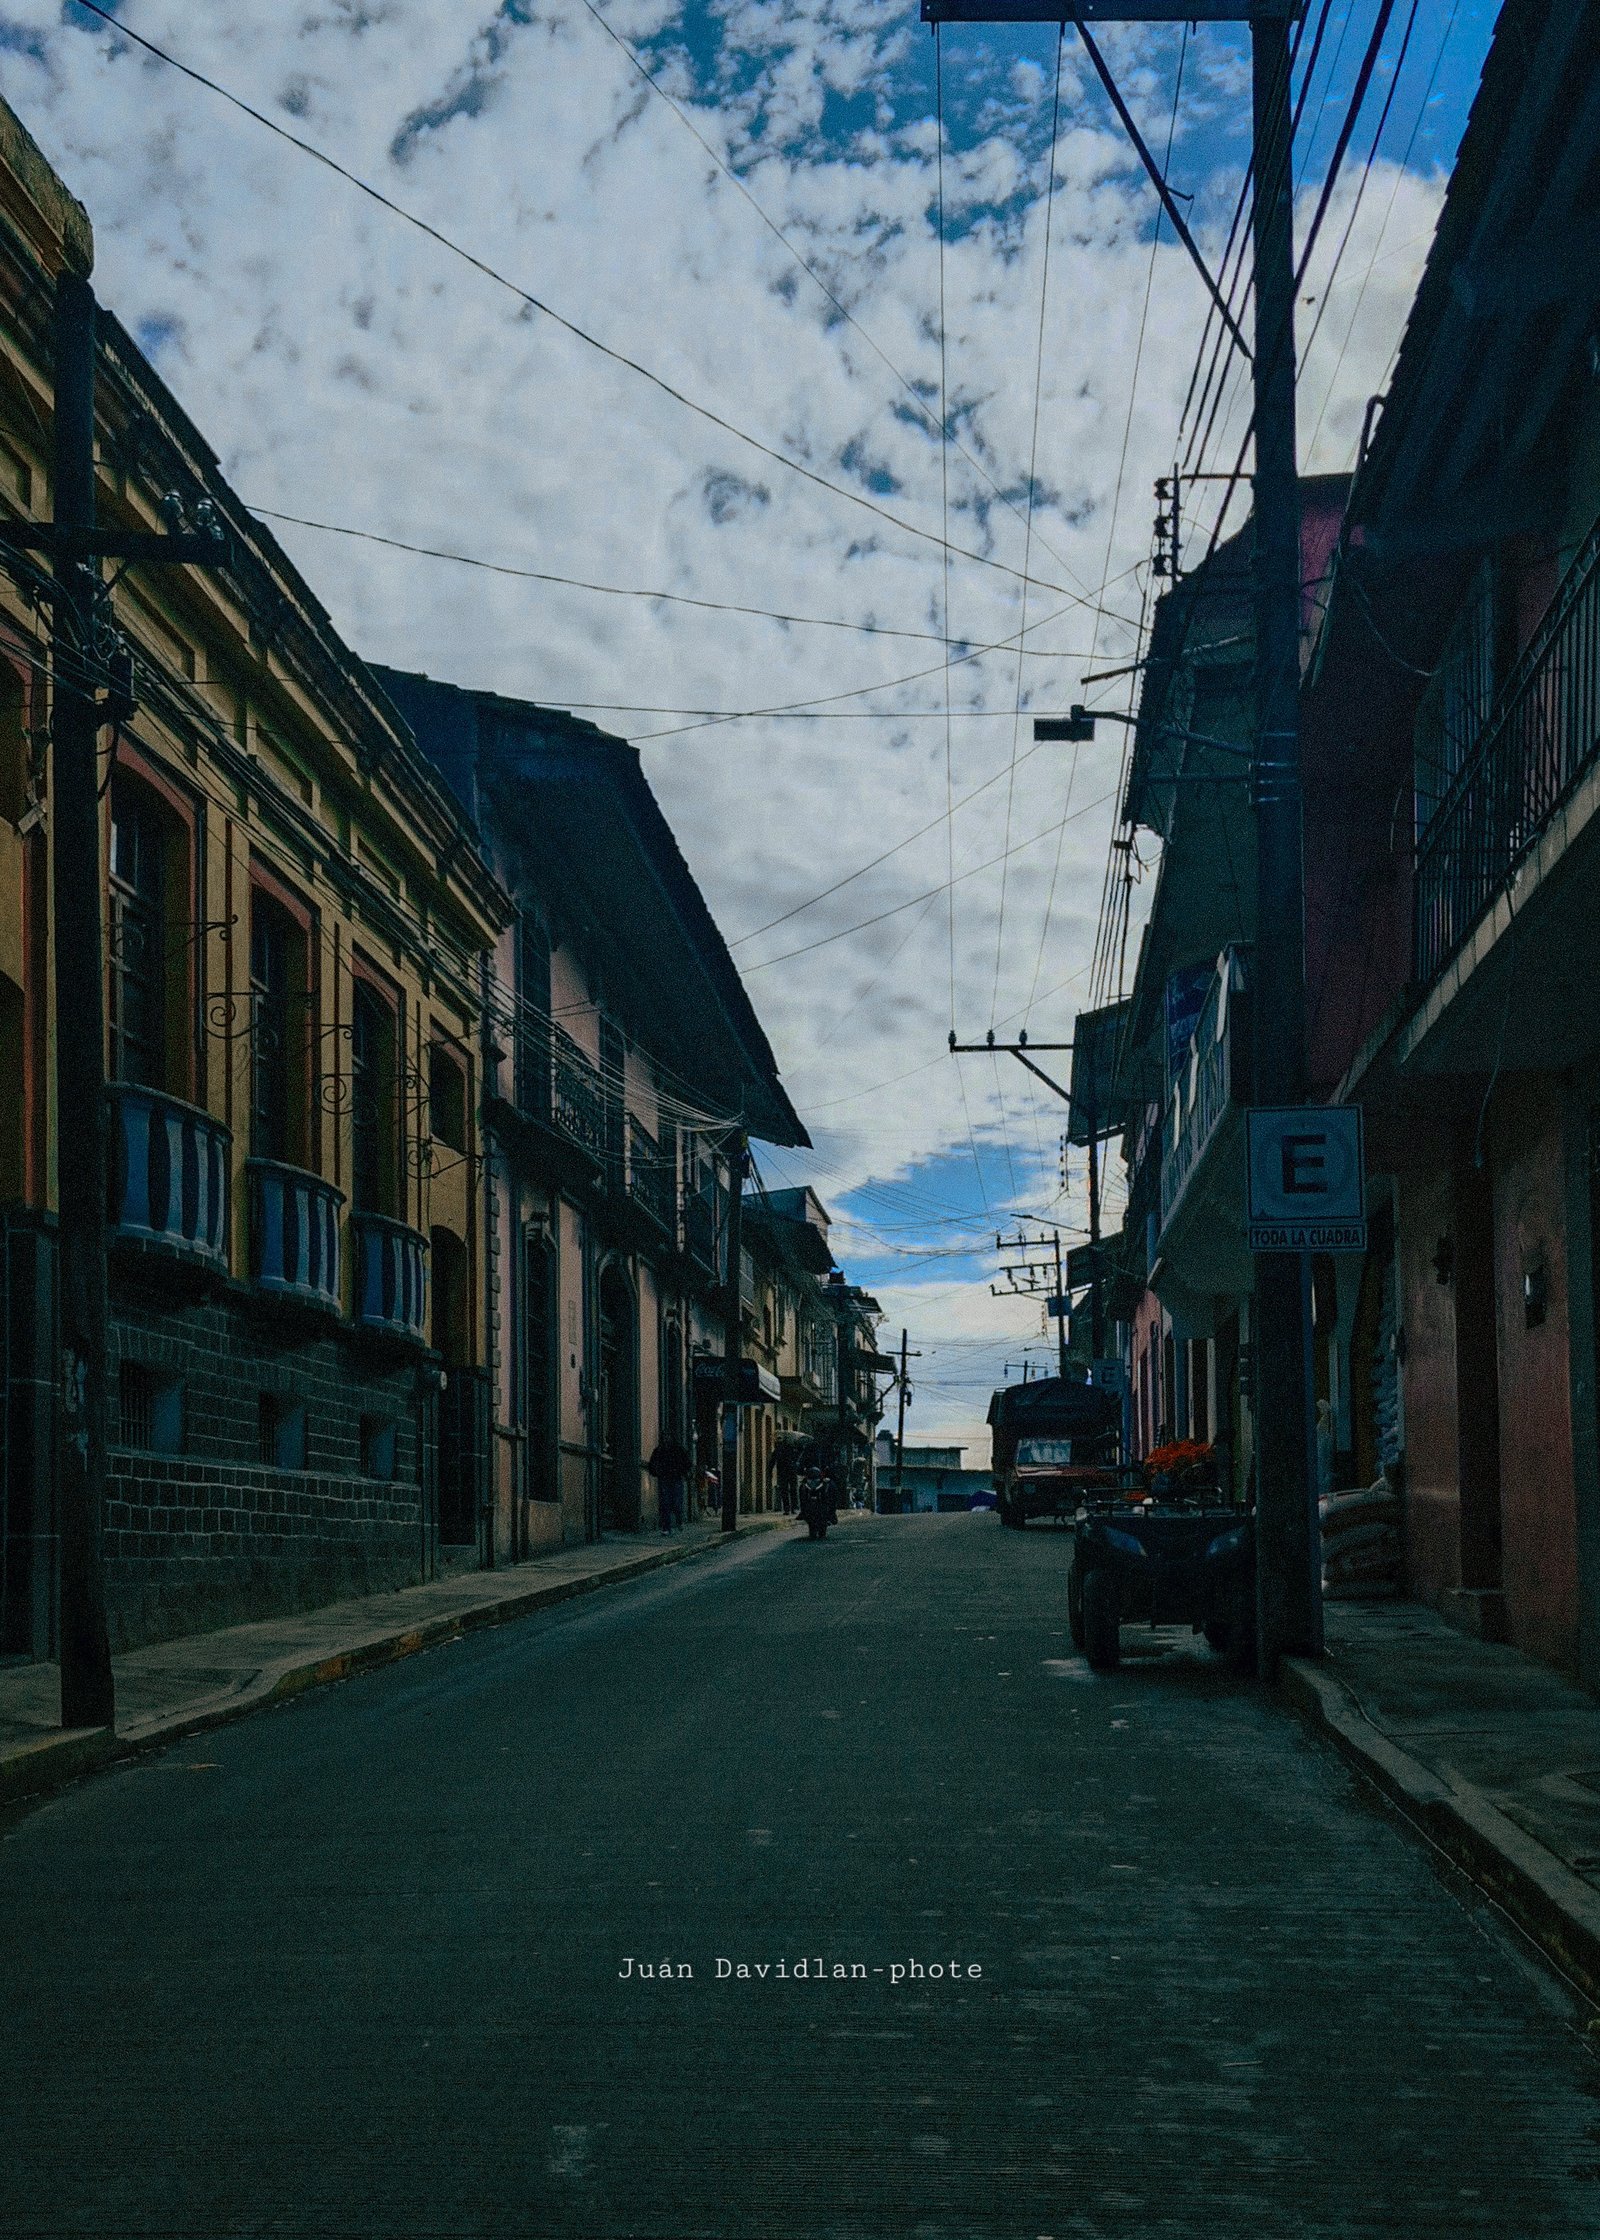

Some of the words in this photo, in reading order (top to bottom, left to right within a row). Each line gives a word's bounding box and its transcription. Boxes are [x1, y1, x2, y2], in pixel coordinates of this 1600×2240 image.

[1282, 1134, 1327, 1194] E
[1254, 1230, 1287, 1245] TODA
[1291, 1229, 1306, 1245] LA
[1309, 1228, 1360, 1245] CUADRA
